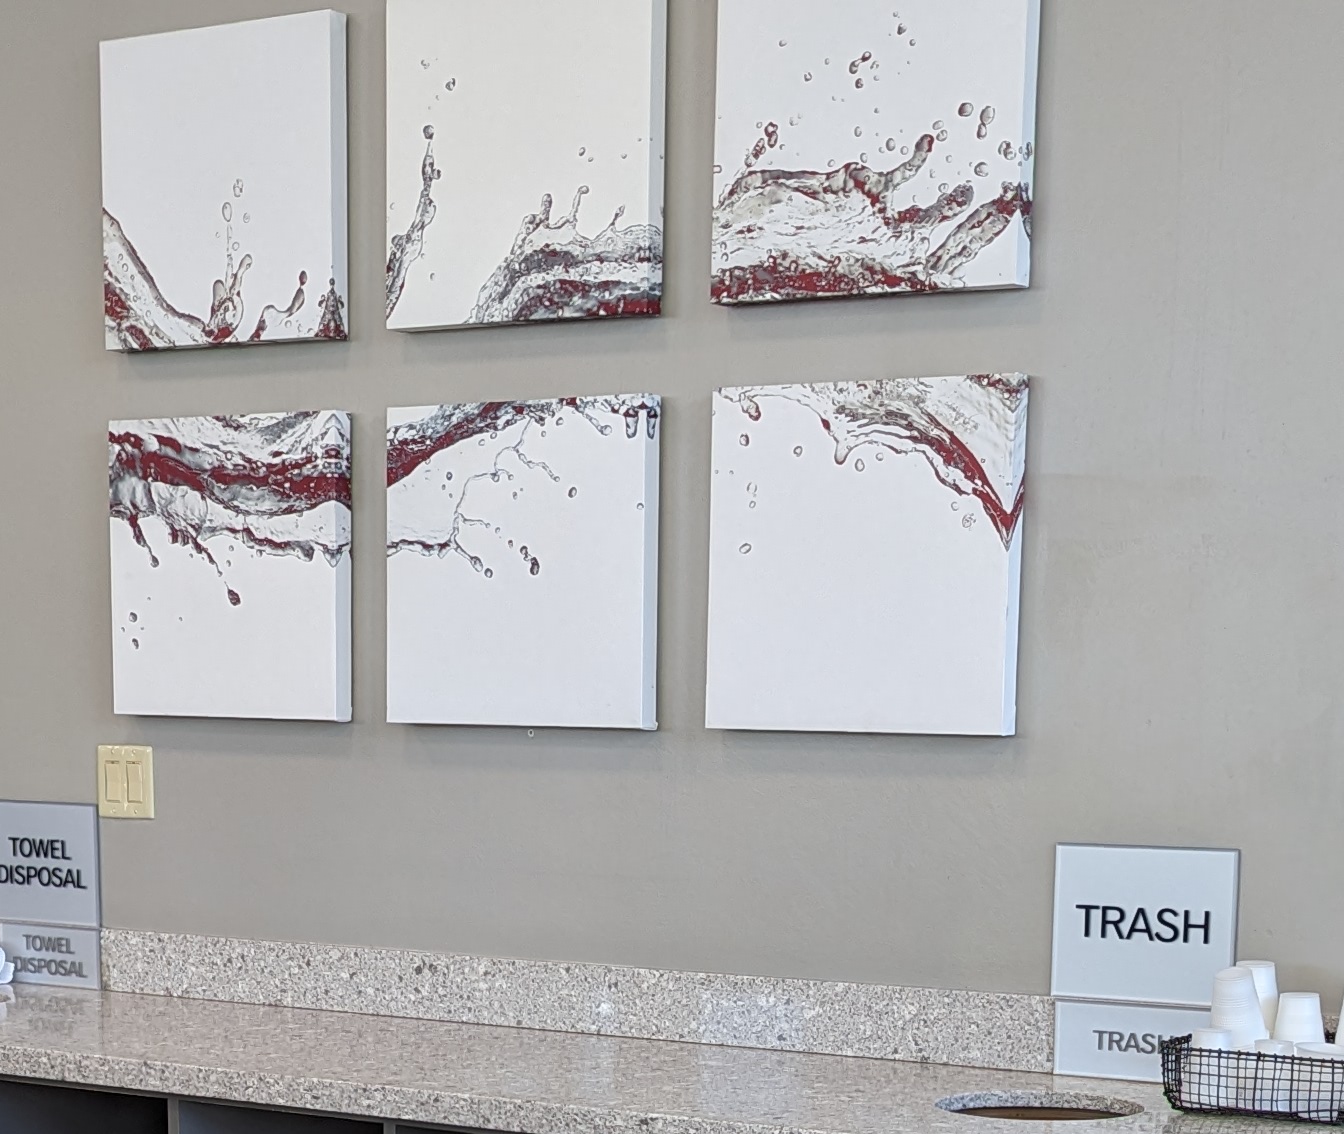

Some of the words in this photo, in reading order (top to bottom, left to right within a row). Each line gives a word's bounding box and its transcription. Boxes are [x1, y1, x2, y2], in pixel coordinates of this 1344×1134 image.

[8, 837, 72, 860] TOWEL
[1075, 904, 1211, 945] TRASH
[22, 934, 75, 955] TOWEL
[12, 956, 88, 978] DISPOSAL
